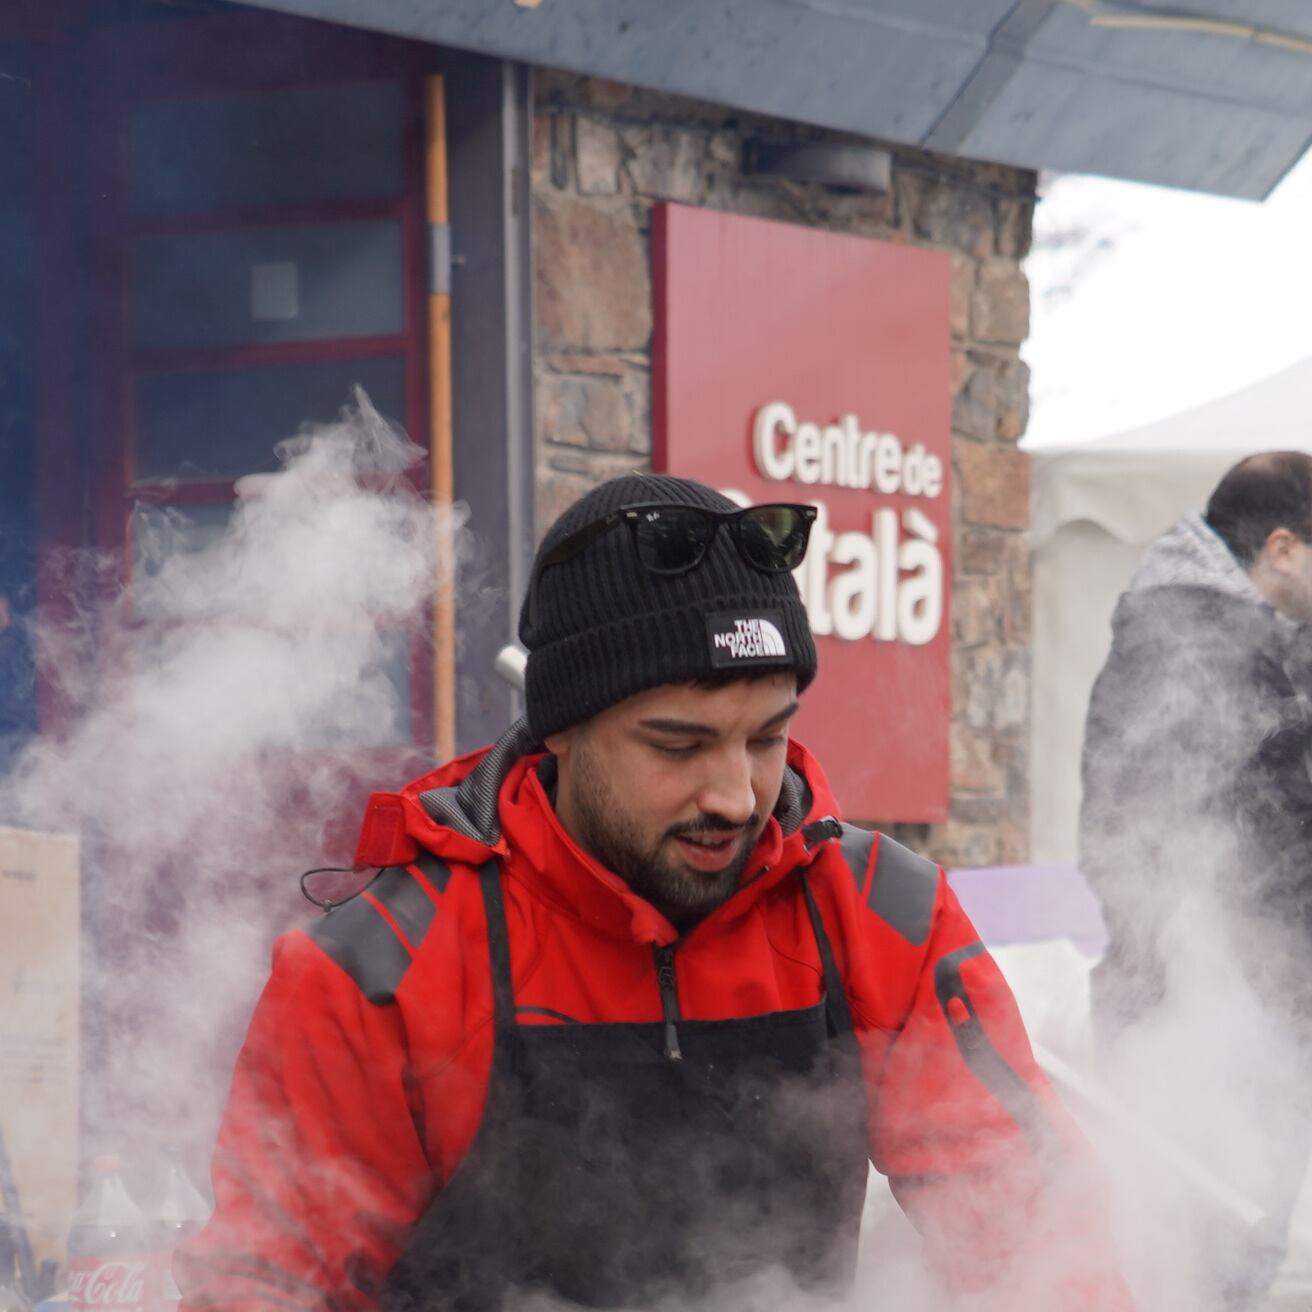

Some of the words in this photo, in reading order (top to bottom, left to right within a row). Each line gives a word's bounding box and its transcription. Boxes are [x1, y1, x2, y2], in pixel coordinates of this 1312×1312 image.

[753, 400, 902, 494] Centre
[902, 443, 943, 498] de
[718, 488, 943, 645] talà
[734, 619, 760, 634] THE
[714, 631, 763, 648] NORTH
[730, 642, 765, 659] FACE
